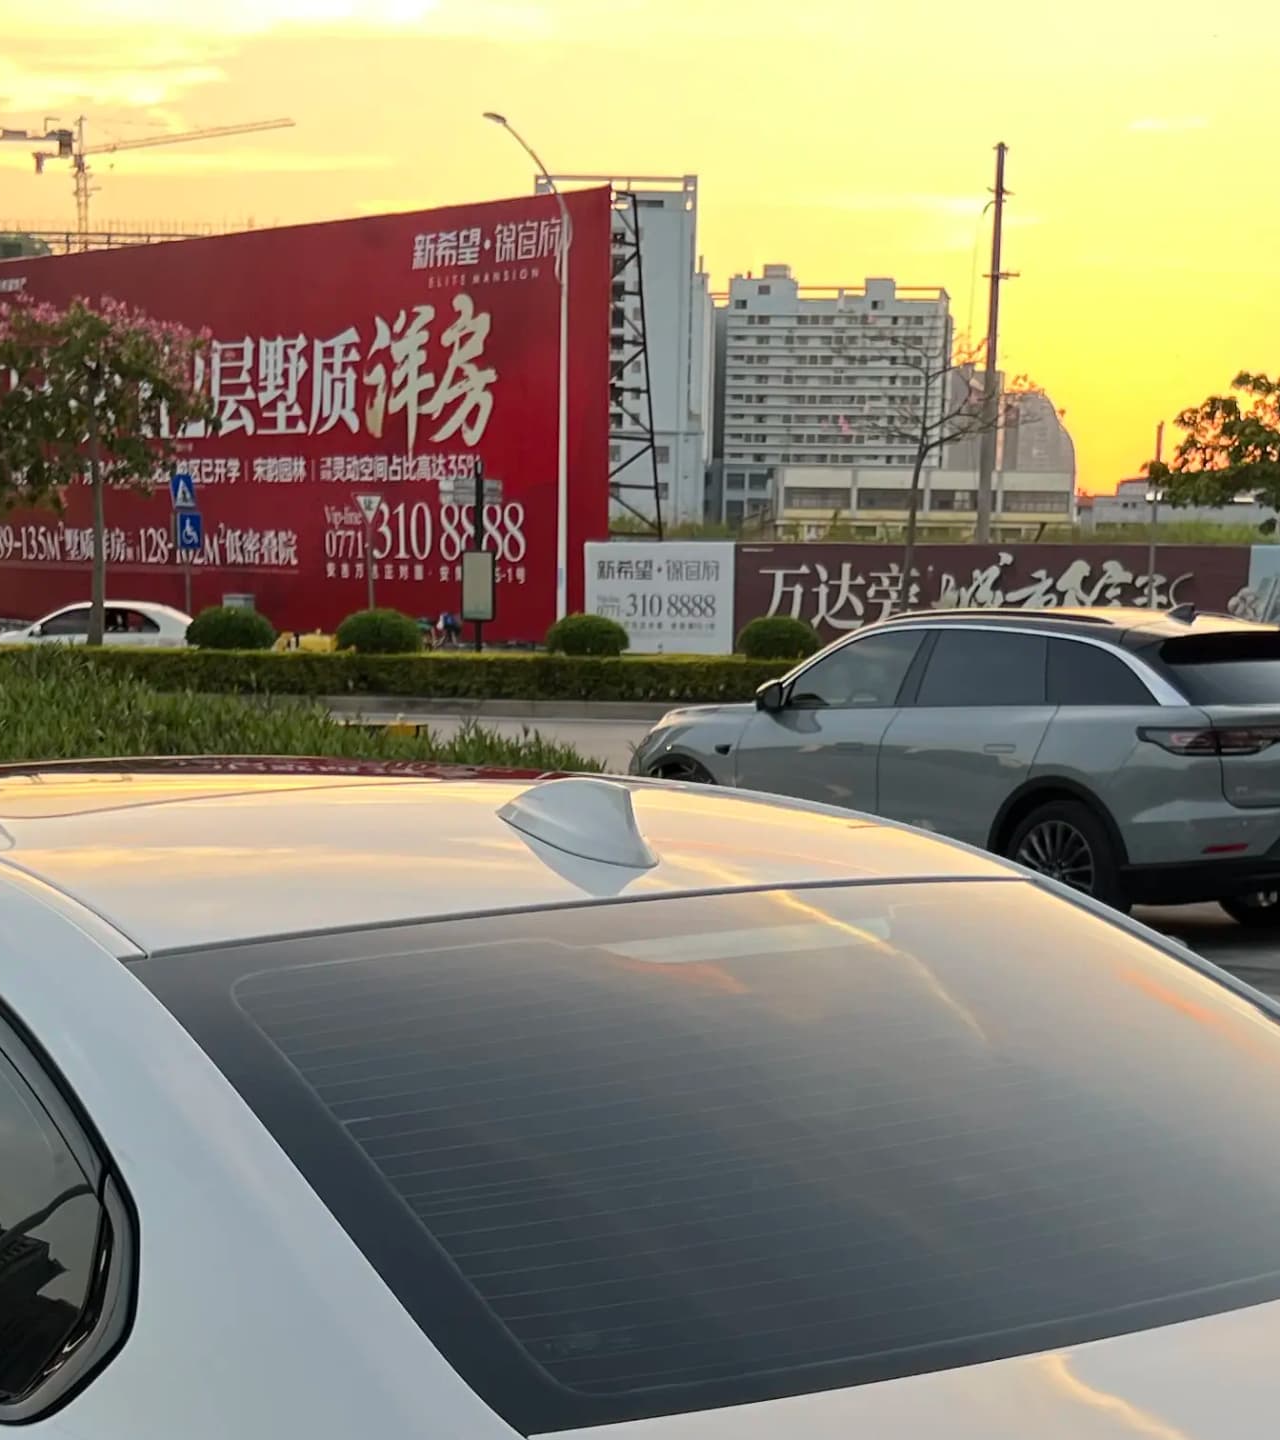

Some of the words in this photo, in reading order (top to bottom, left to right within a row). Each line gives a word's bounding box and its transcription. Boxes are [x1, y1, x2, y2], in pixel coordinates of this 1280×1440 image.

[472, 268, 540, 285] MANSION
[373, 501, 433, 561] 310
[625, 593, 663, 618] 310
[666, 593, 716, 619] 8888
